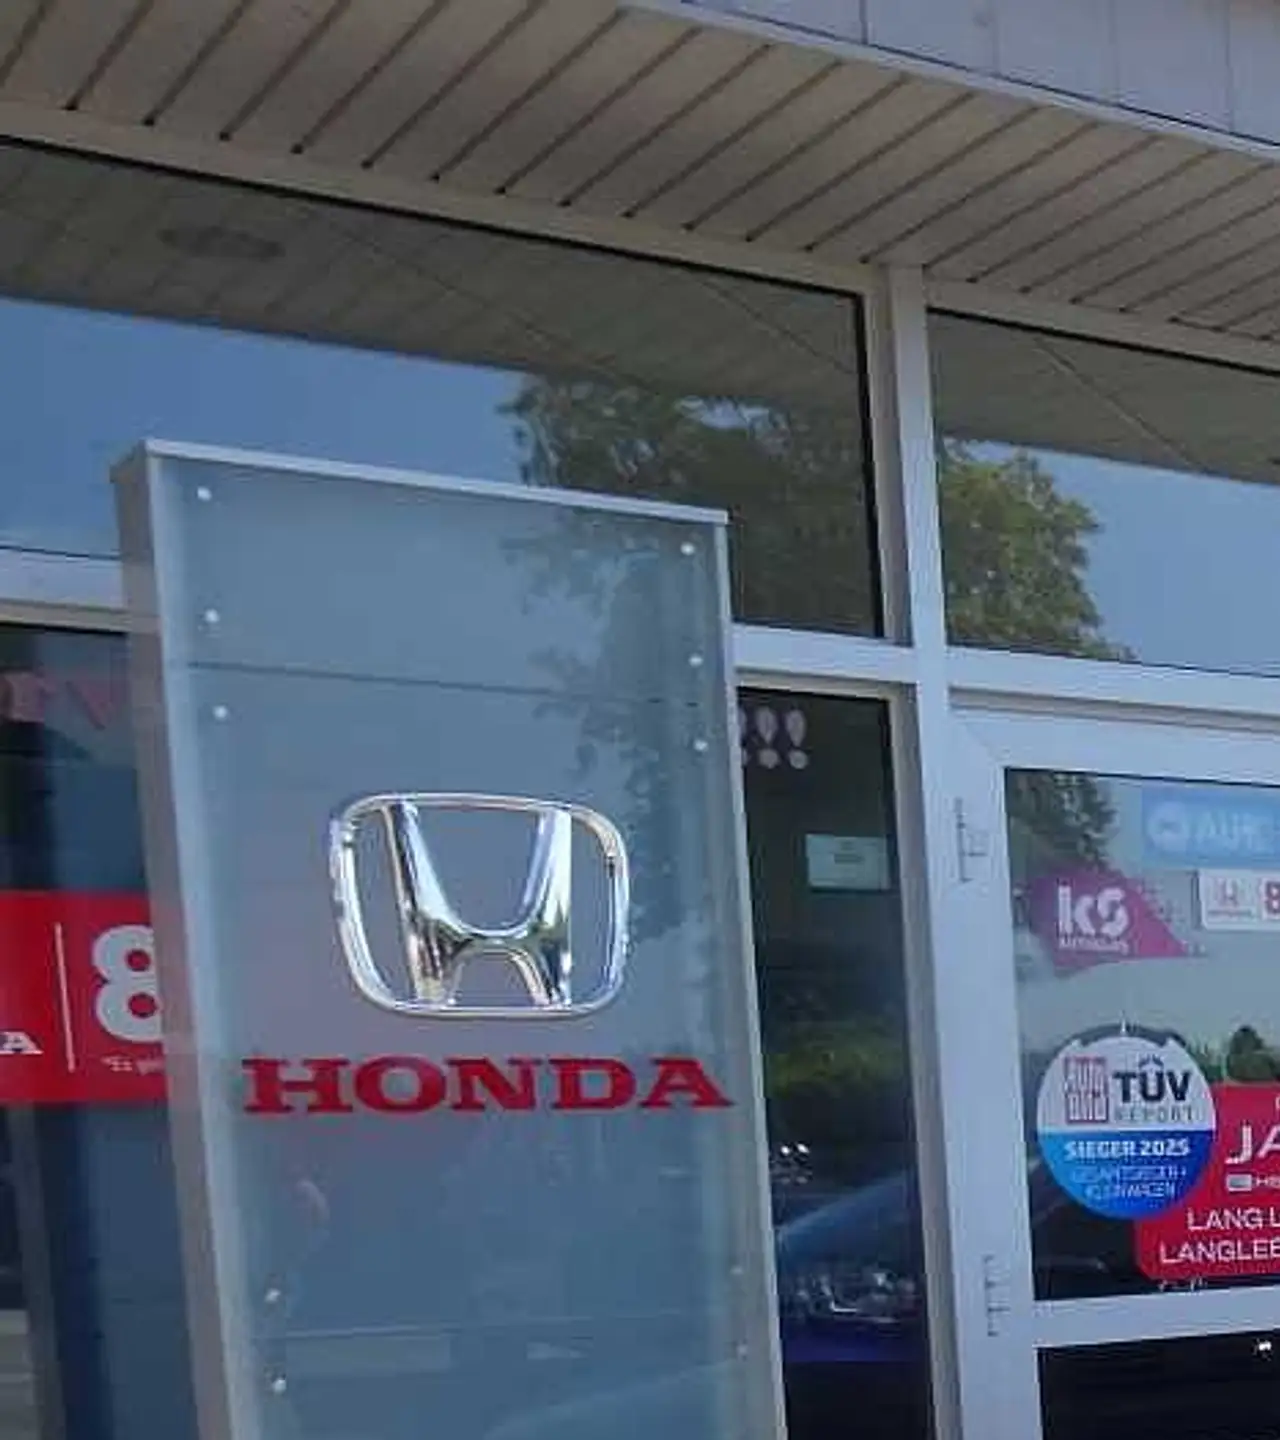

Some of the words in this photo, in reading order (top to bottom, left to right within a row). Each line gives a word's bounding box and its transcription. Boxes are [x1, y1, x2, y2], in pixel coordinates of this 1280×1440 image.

[92, 923, 163, 1043] 8
[241, 1056, 736, 1113] HONDA
[1112, 1054, 1192, 1103] TÜV
[1064, 1140, 1136, 1162] SIEGER
[1140, 1138, 1191, 1157] 2025
[1187, 1207, 1264, 1231] LANG
